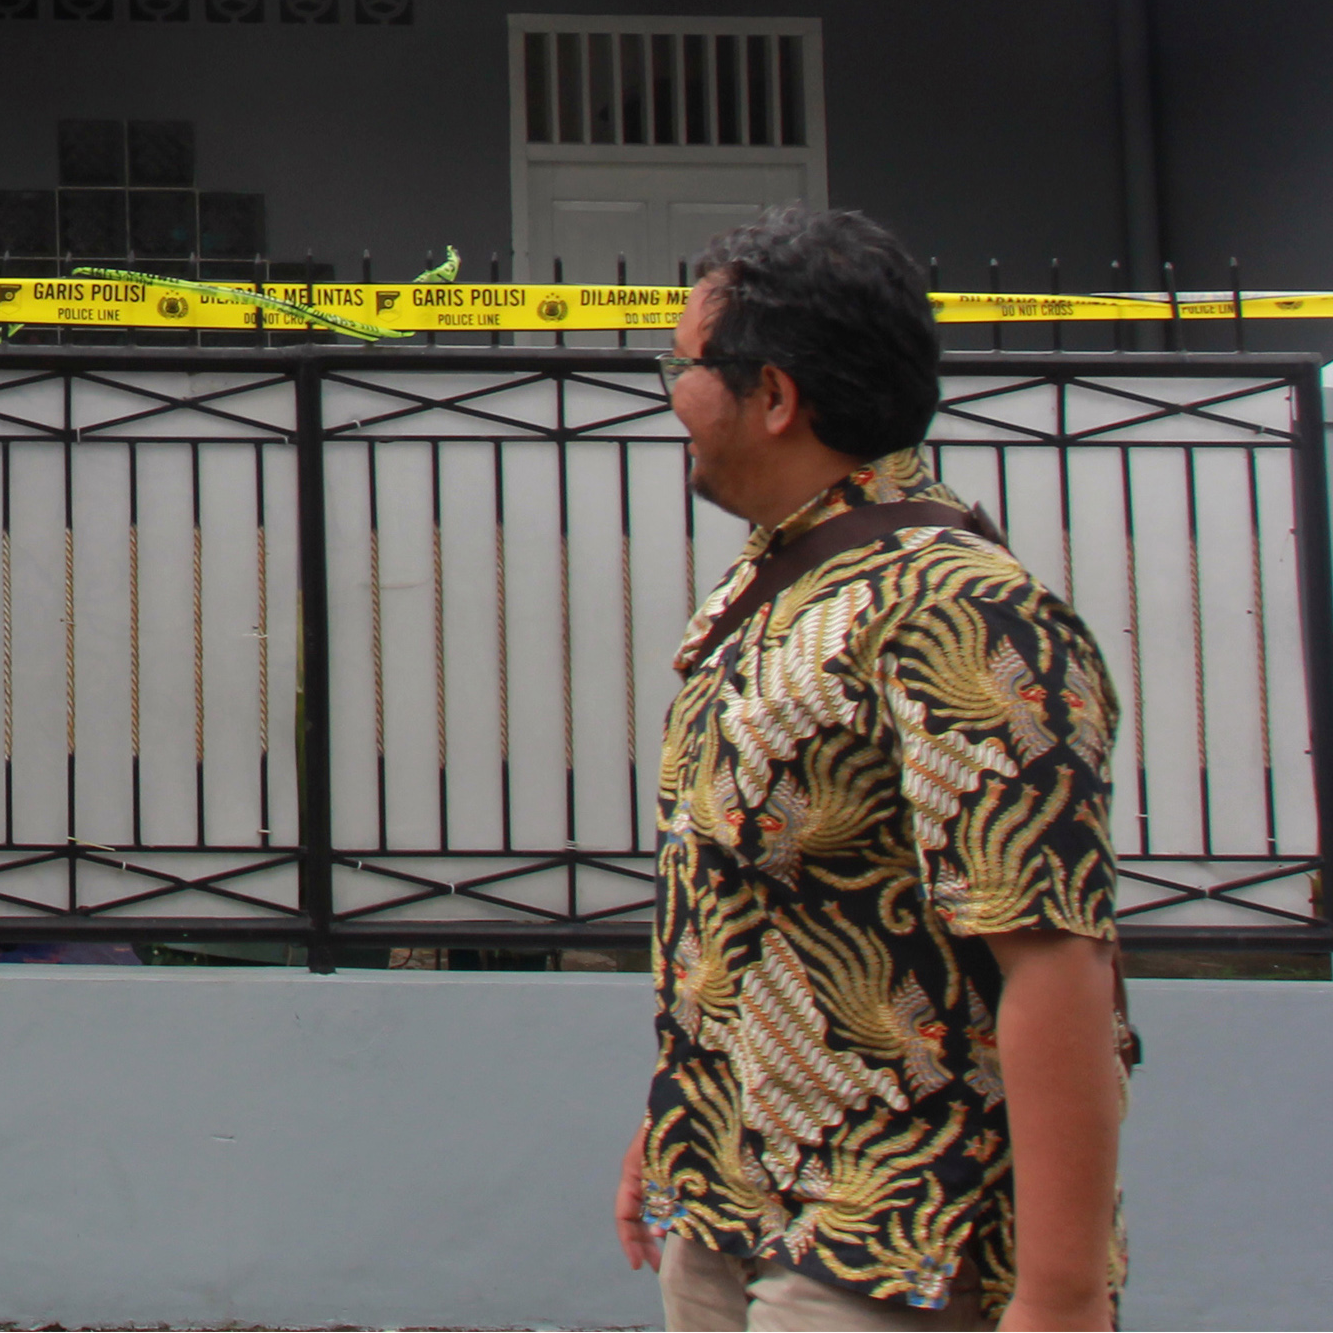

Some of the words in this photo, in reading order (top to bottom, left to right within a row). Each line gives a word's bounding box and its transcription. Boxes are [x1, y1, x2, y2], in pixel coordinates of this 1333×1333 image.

[33, 283, 85, 301] GARIS
[91, 284, 146, 303] POLISI
[412, 288, 464, 307] GARIS
[470, 288, 526, 307] POLISI
[580, 289, 661, 307] DILARANG
[58, 307, 92, 321] POLICE
[95, 307, 121, 321] LINE
[1002, 304, 1016, 317] DO
[1019, 304, 1037, 316] NOT
[1041, 304, 1074, 316] CROSS
[1219, 304, 1235, 314] LIN
[437, 313, 474, 326] POLICE
[477, 313, 501, 326] LINE
[625, 312, 639, 324] DO
[642, 312, 661, 324] NOT
[665, 312, 685, 324] CRO
